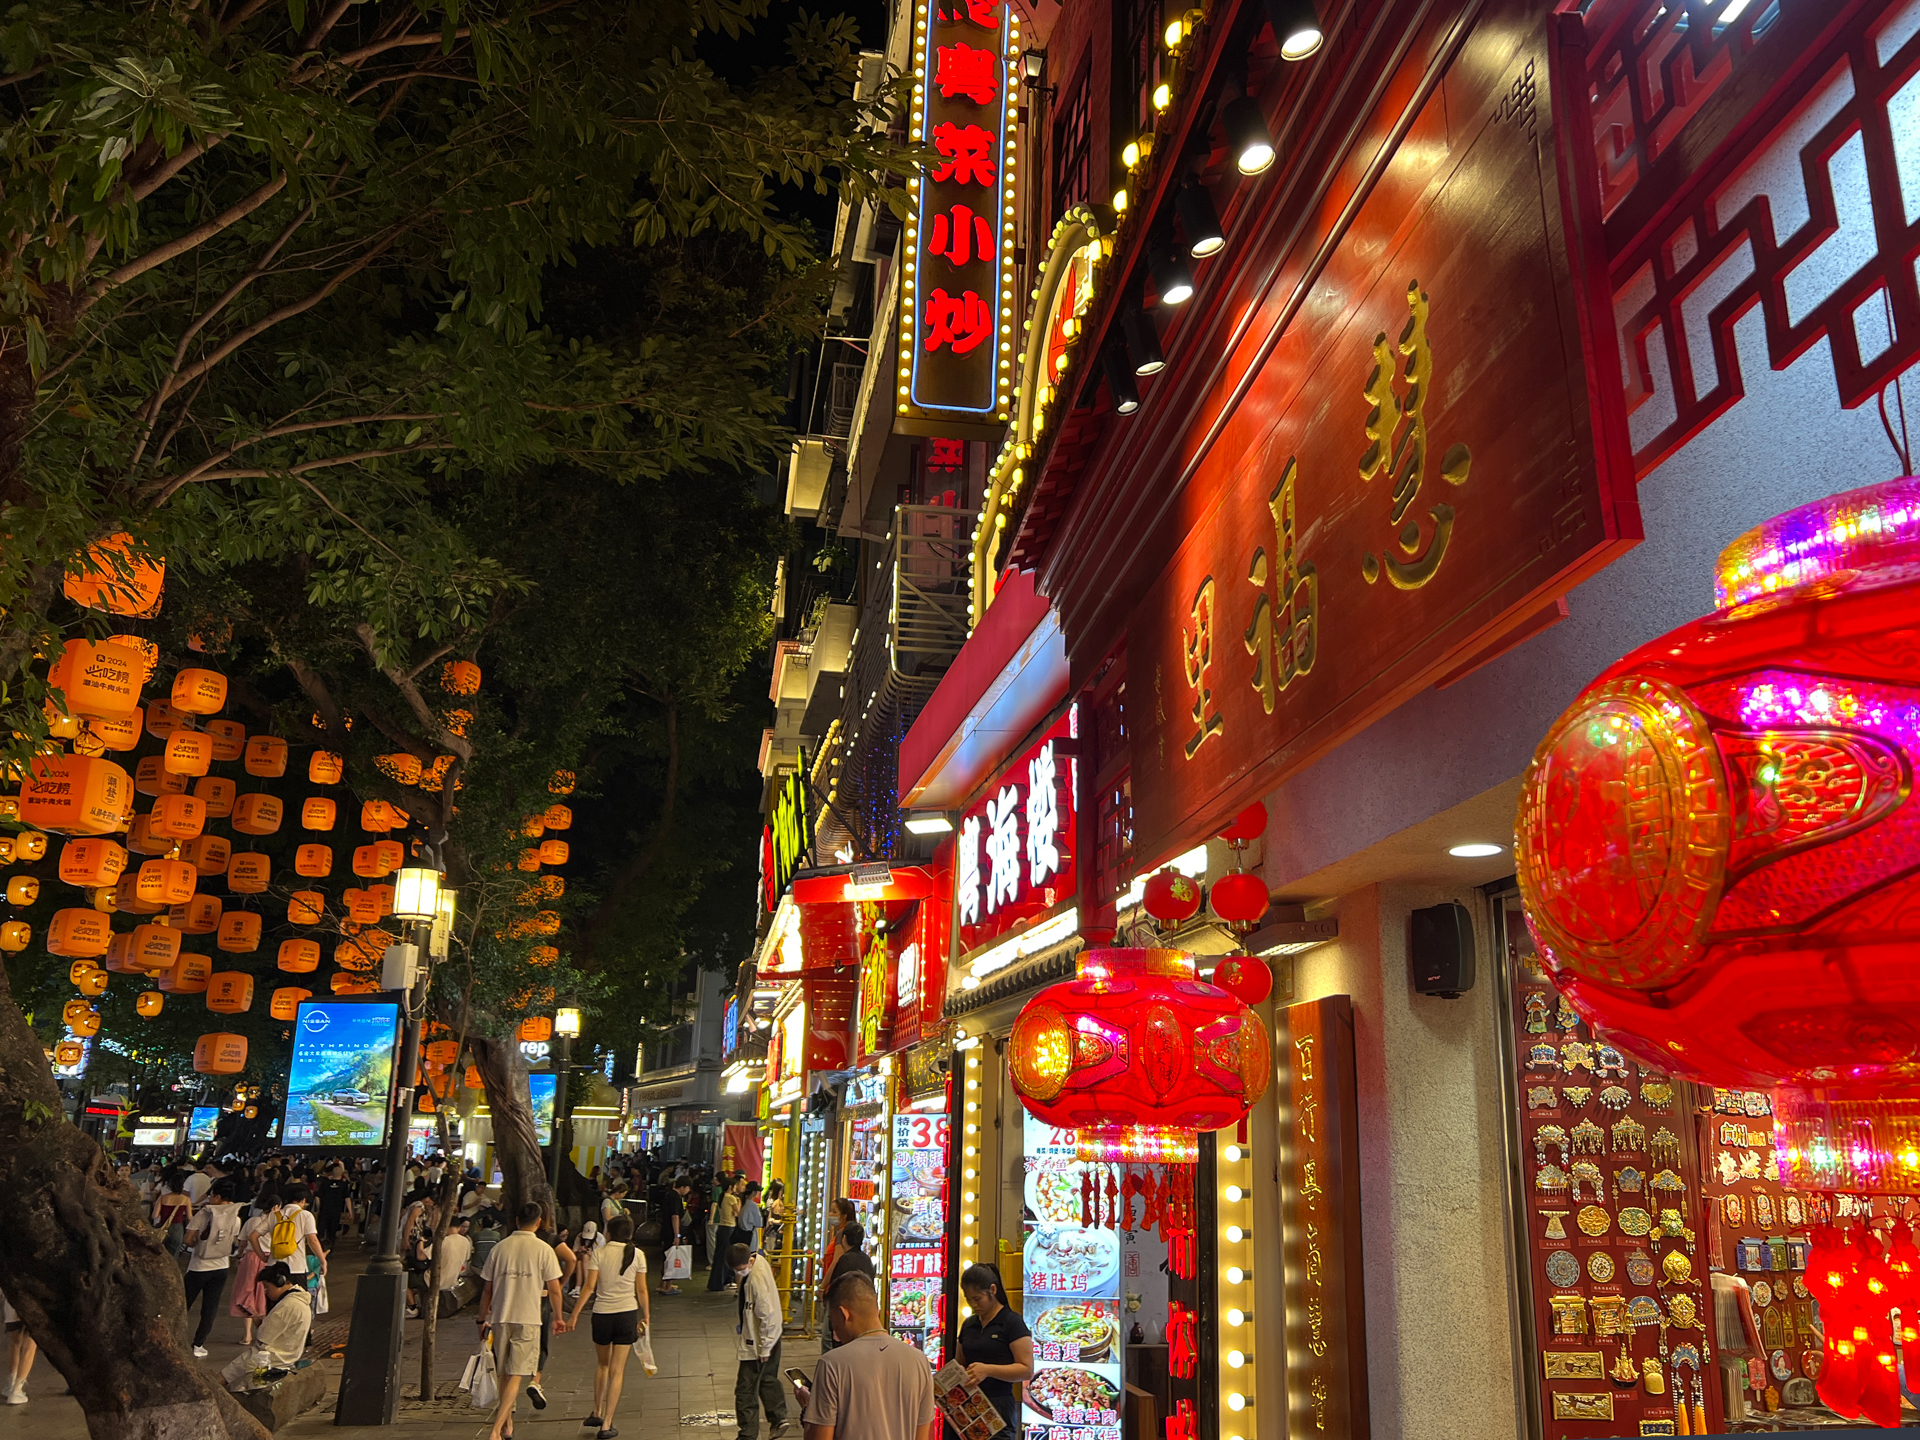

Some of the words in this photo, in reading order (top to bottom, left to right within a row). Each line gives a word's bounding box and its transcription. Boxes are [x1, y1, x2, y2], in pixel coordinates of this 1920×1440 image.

[107, 657, 127, 668] 2024
[84, 664, 130, 683] 必吃榜
[83, 678, 130, 695] 潮汕牛肉火锅
[51, 770, 69, 778] 2024
[897, 1116, 910, 1148] 特价菜
[911, 1117, 947, 1148] 38
[1049, 1126, 1076, 1146] 28
[1026, 1158, 1067, 1172] 水煮鱼
[1030, 1271, 1088, 1293] 猪肚鸡
[1052, 1406, 1118, 1425] 铁板牛肉
